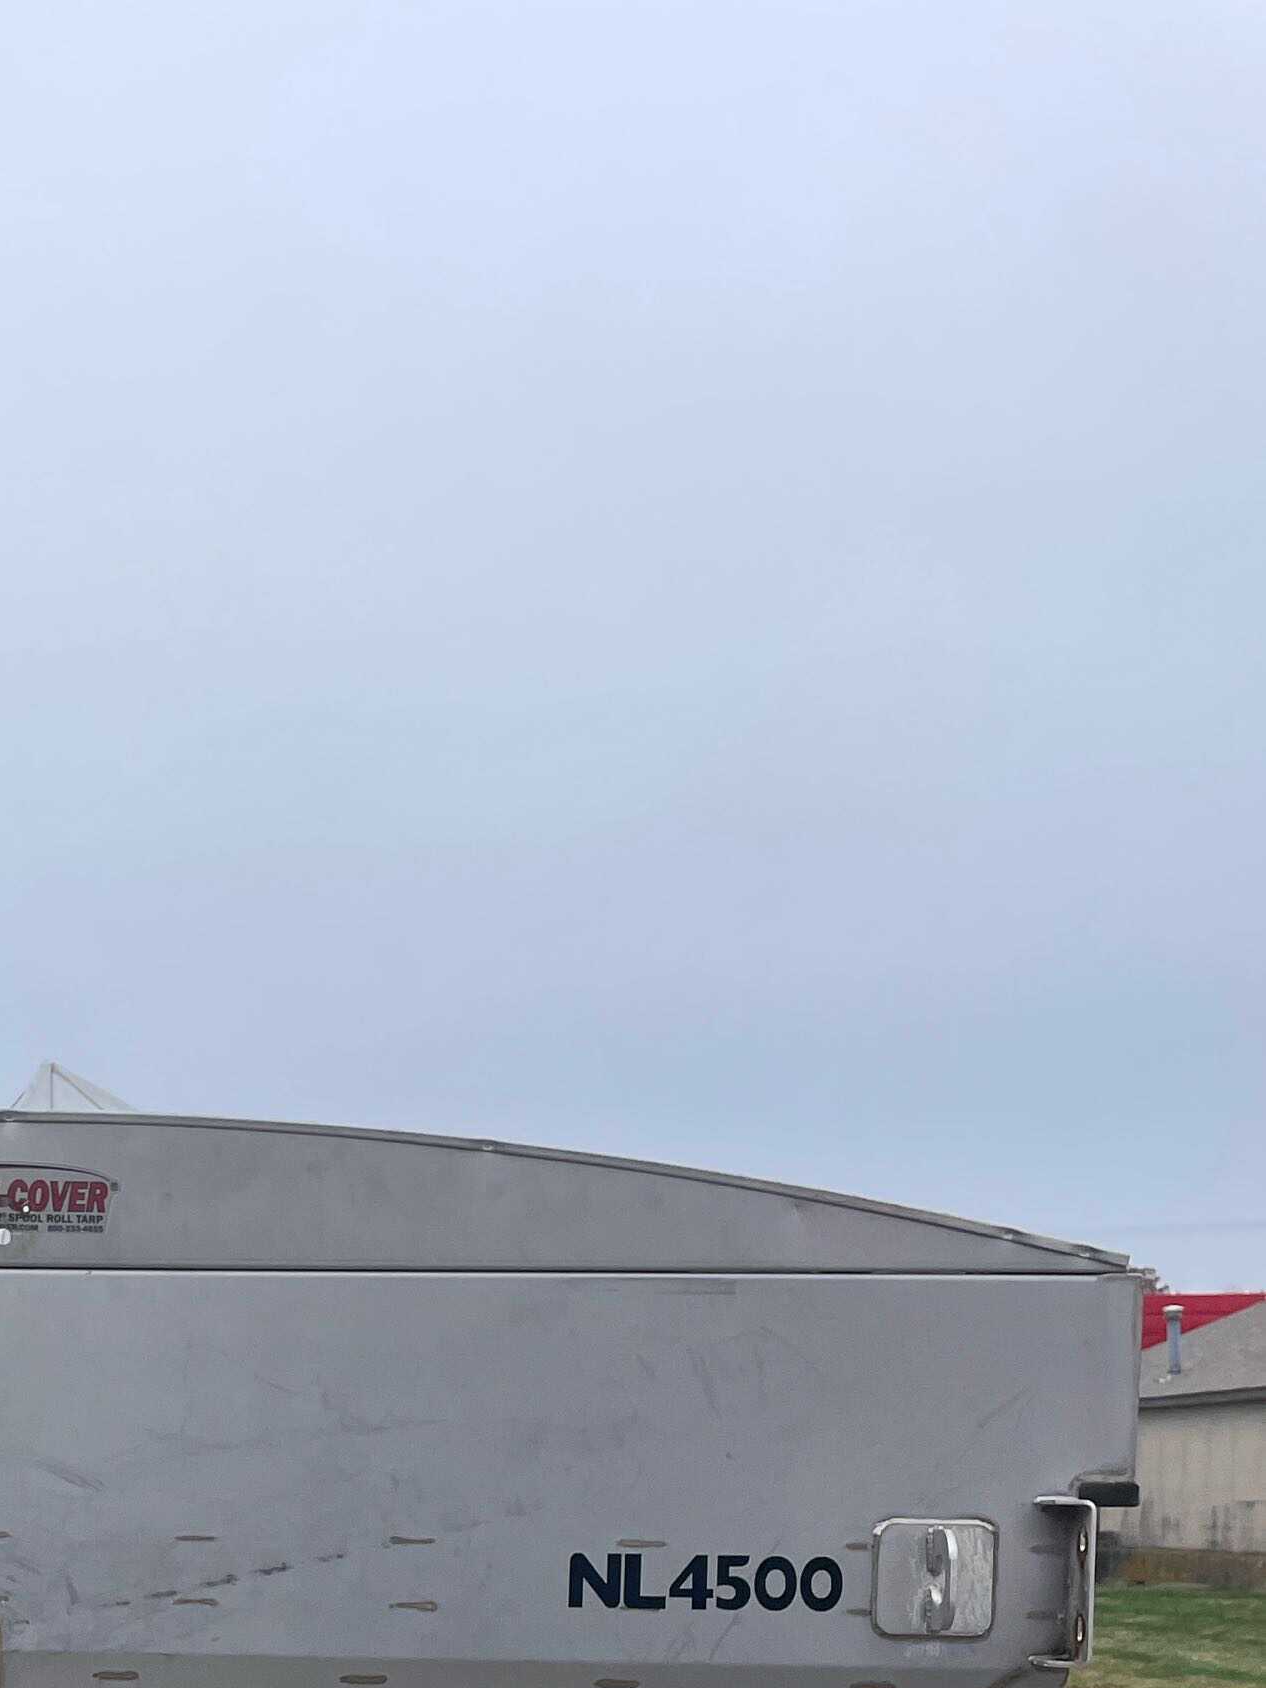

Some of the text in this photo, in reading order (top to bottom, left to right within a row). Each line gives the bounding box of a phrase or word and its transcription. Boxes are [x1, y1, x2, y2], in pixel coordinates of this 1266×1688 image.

[9, 1213, 43, 1223] SPOOL
[46, 1214, 73, 1224] ROLL
[76, 1214, 104, 1225] TARP
[568, 1552, 843, 1612] NL4500
